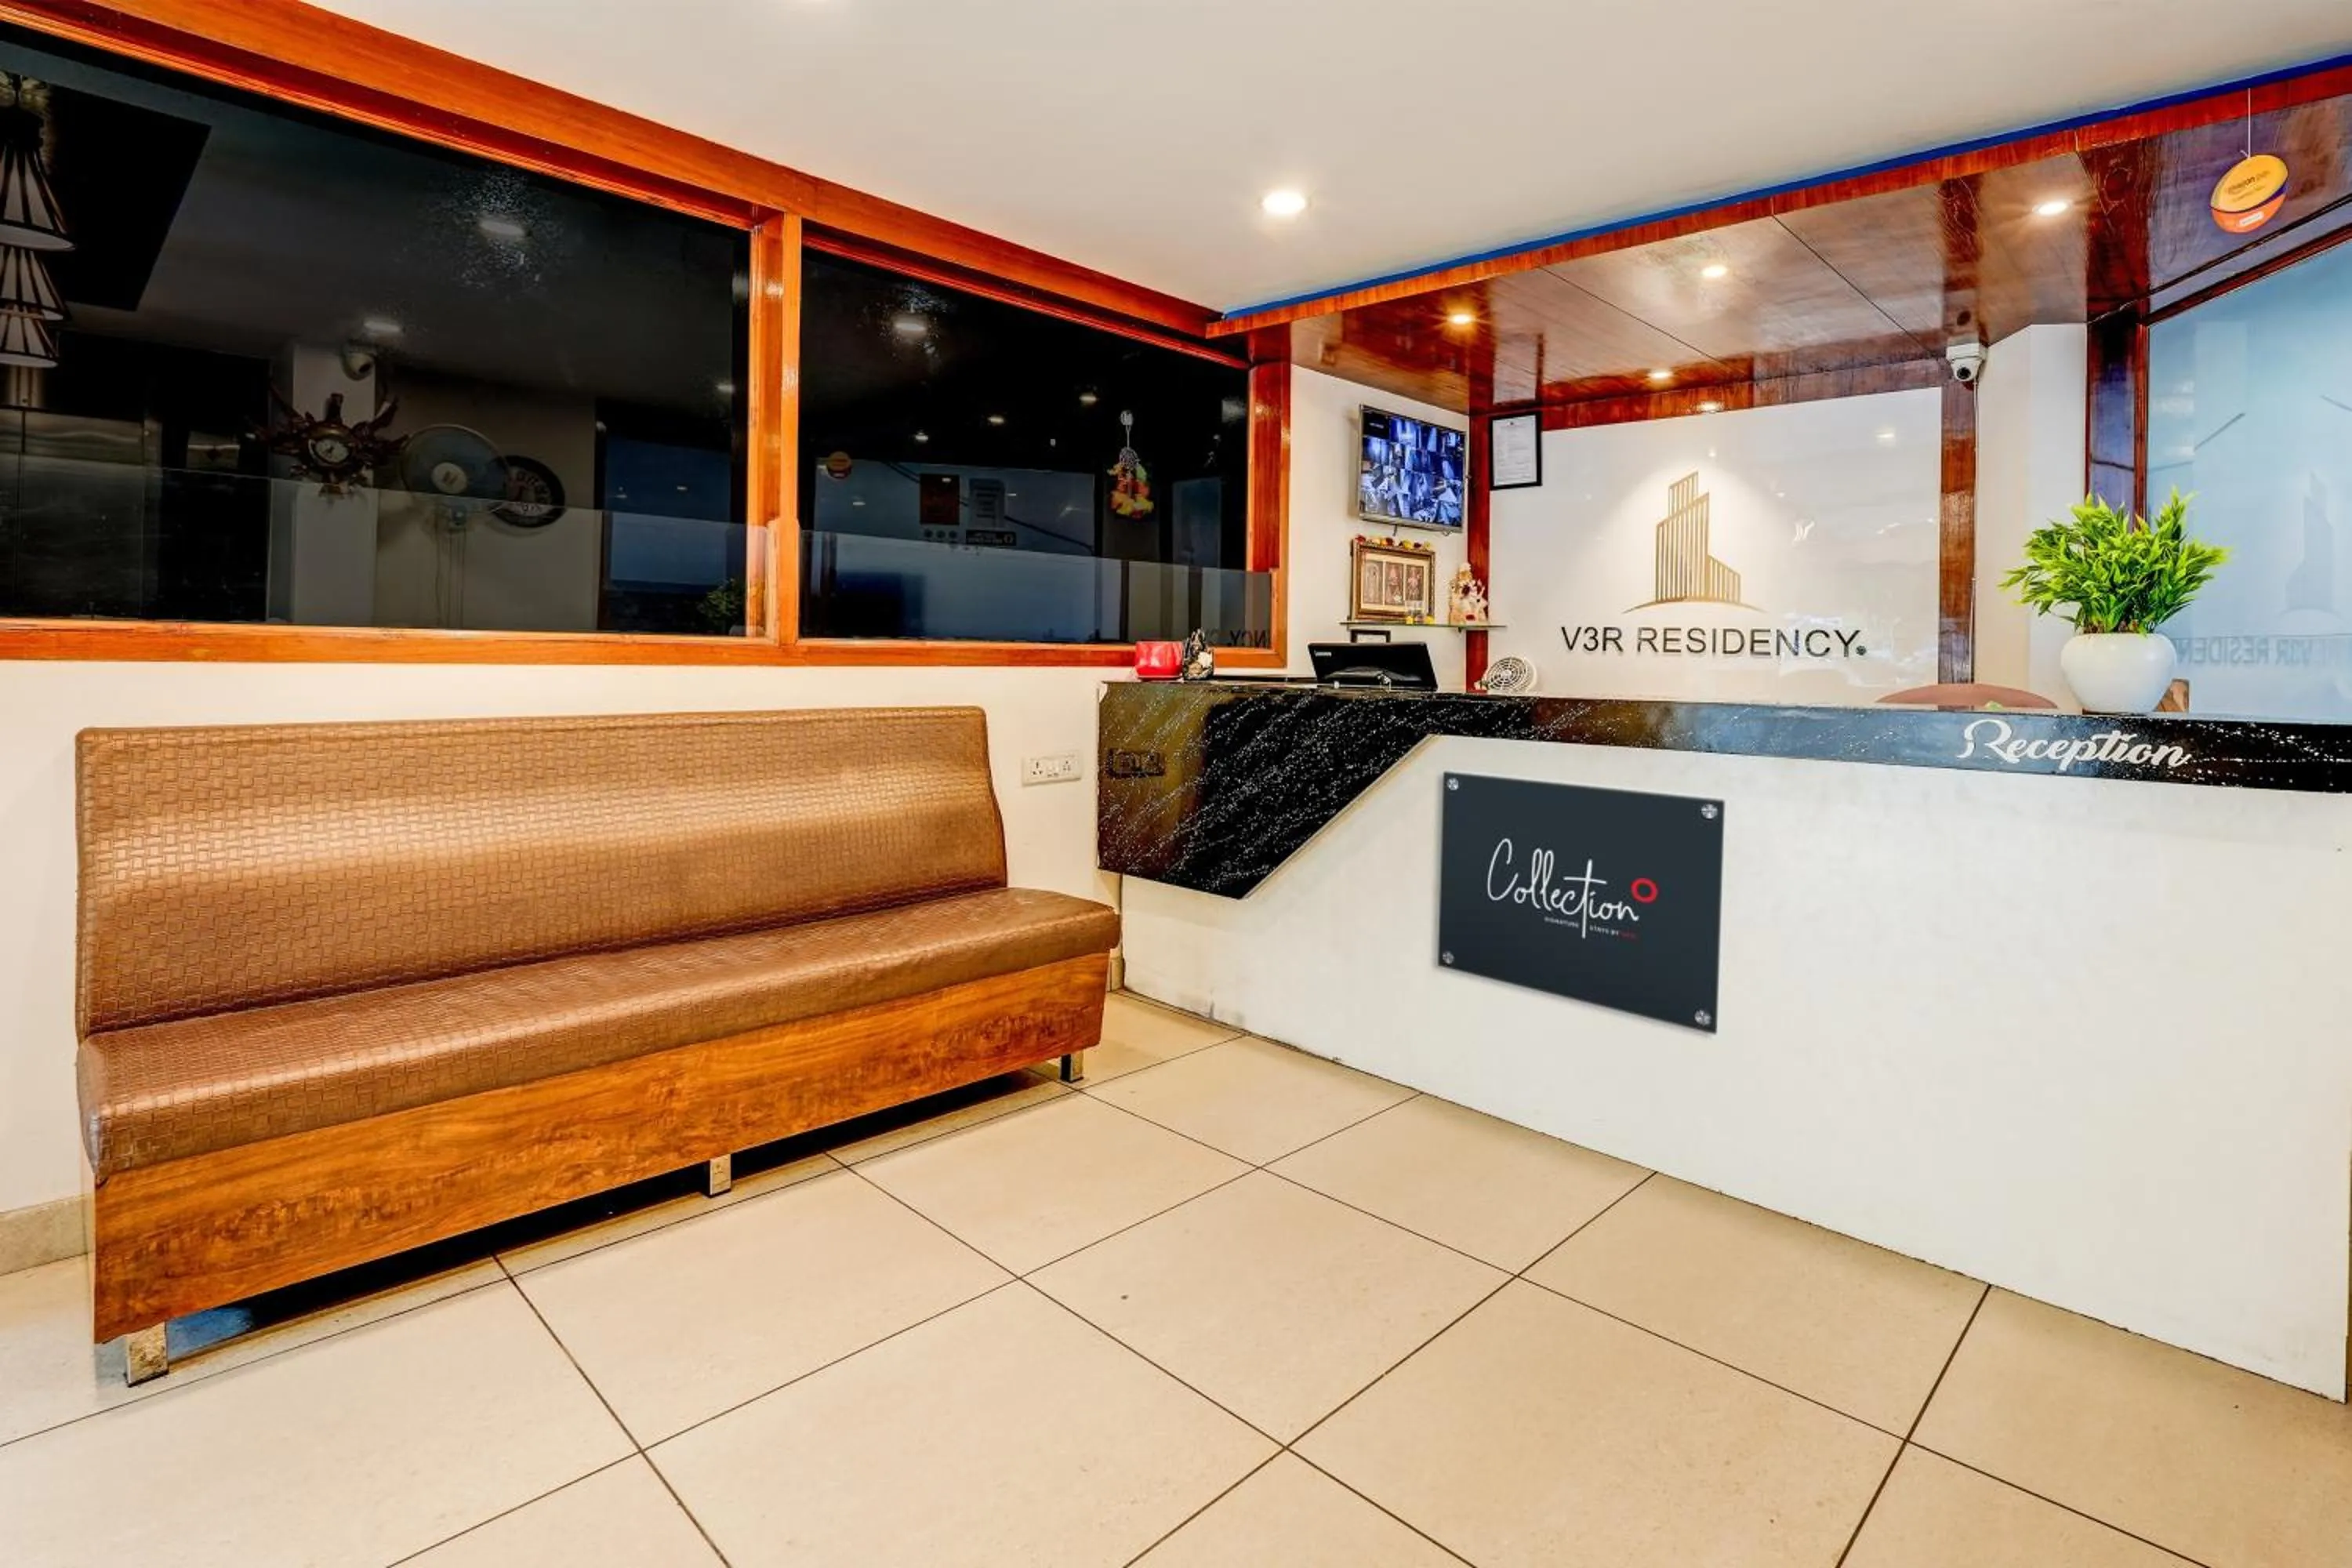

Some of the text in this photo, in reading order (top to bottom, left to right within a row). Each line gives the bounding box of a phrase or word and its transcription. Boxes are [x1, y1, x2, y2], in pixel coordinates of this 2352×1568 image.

[1561, 626, 1624, 653] V3R
[1957, 719, 2193, 771] Reception
[1487, 837, 1639, 939] Collection
